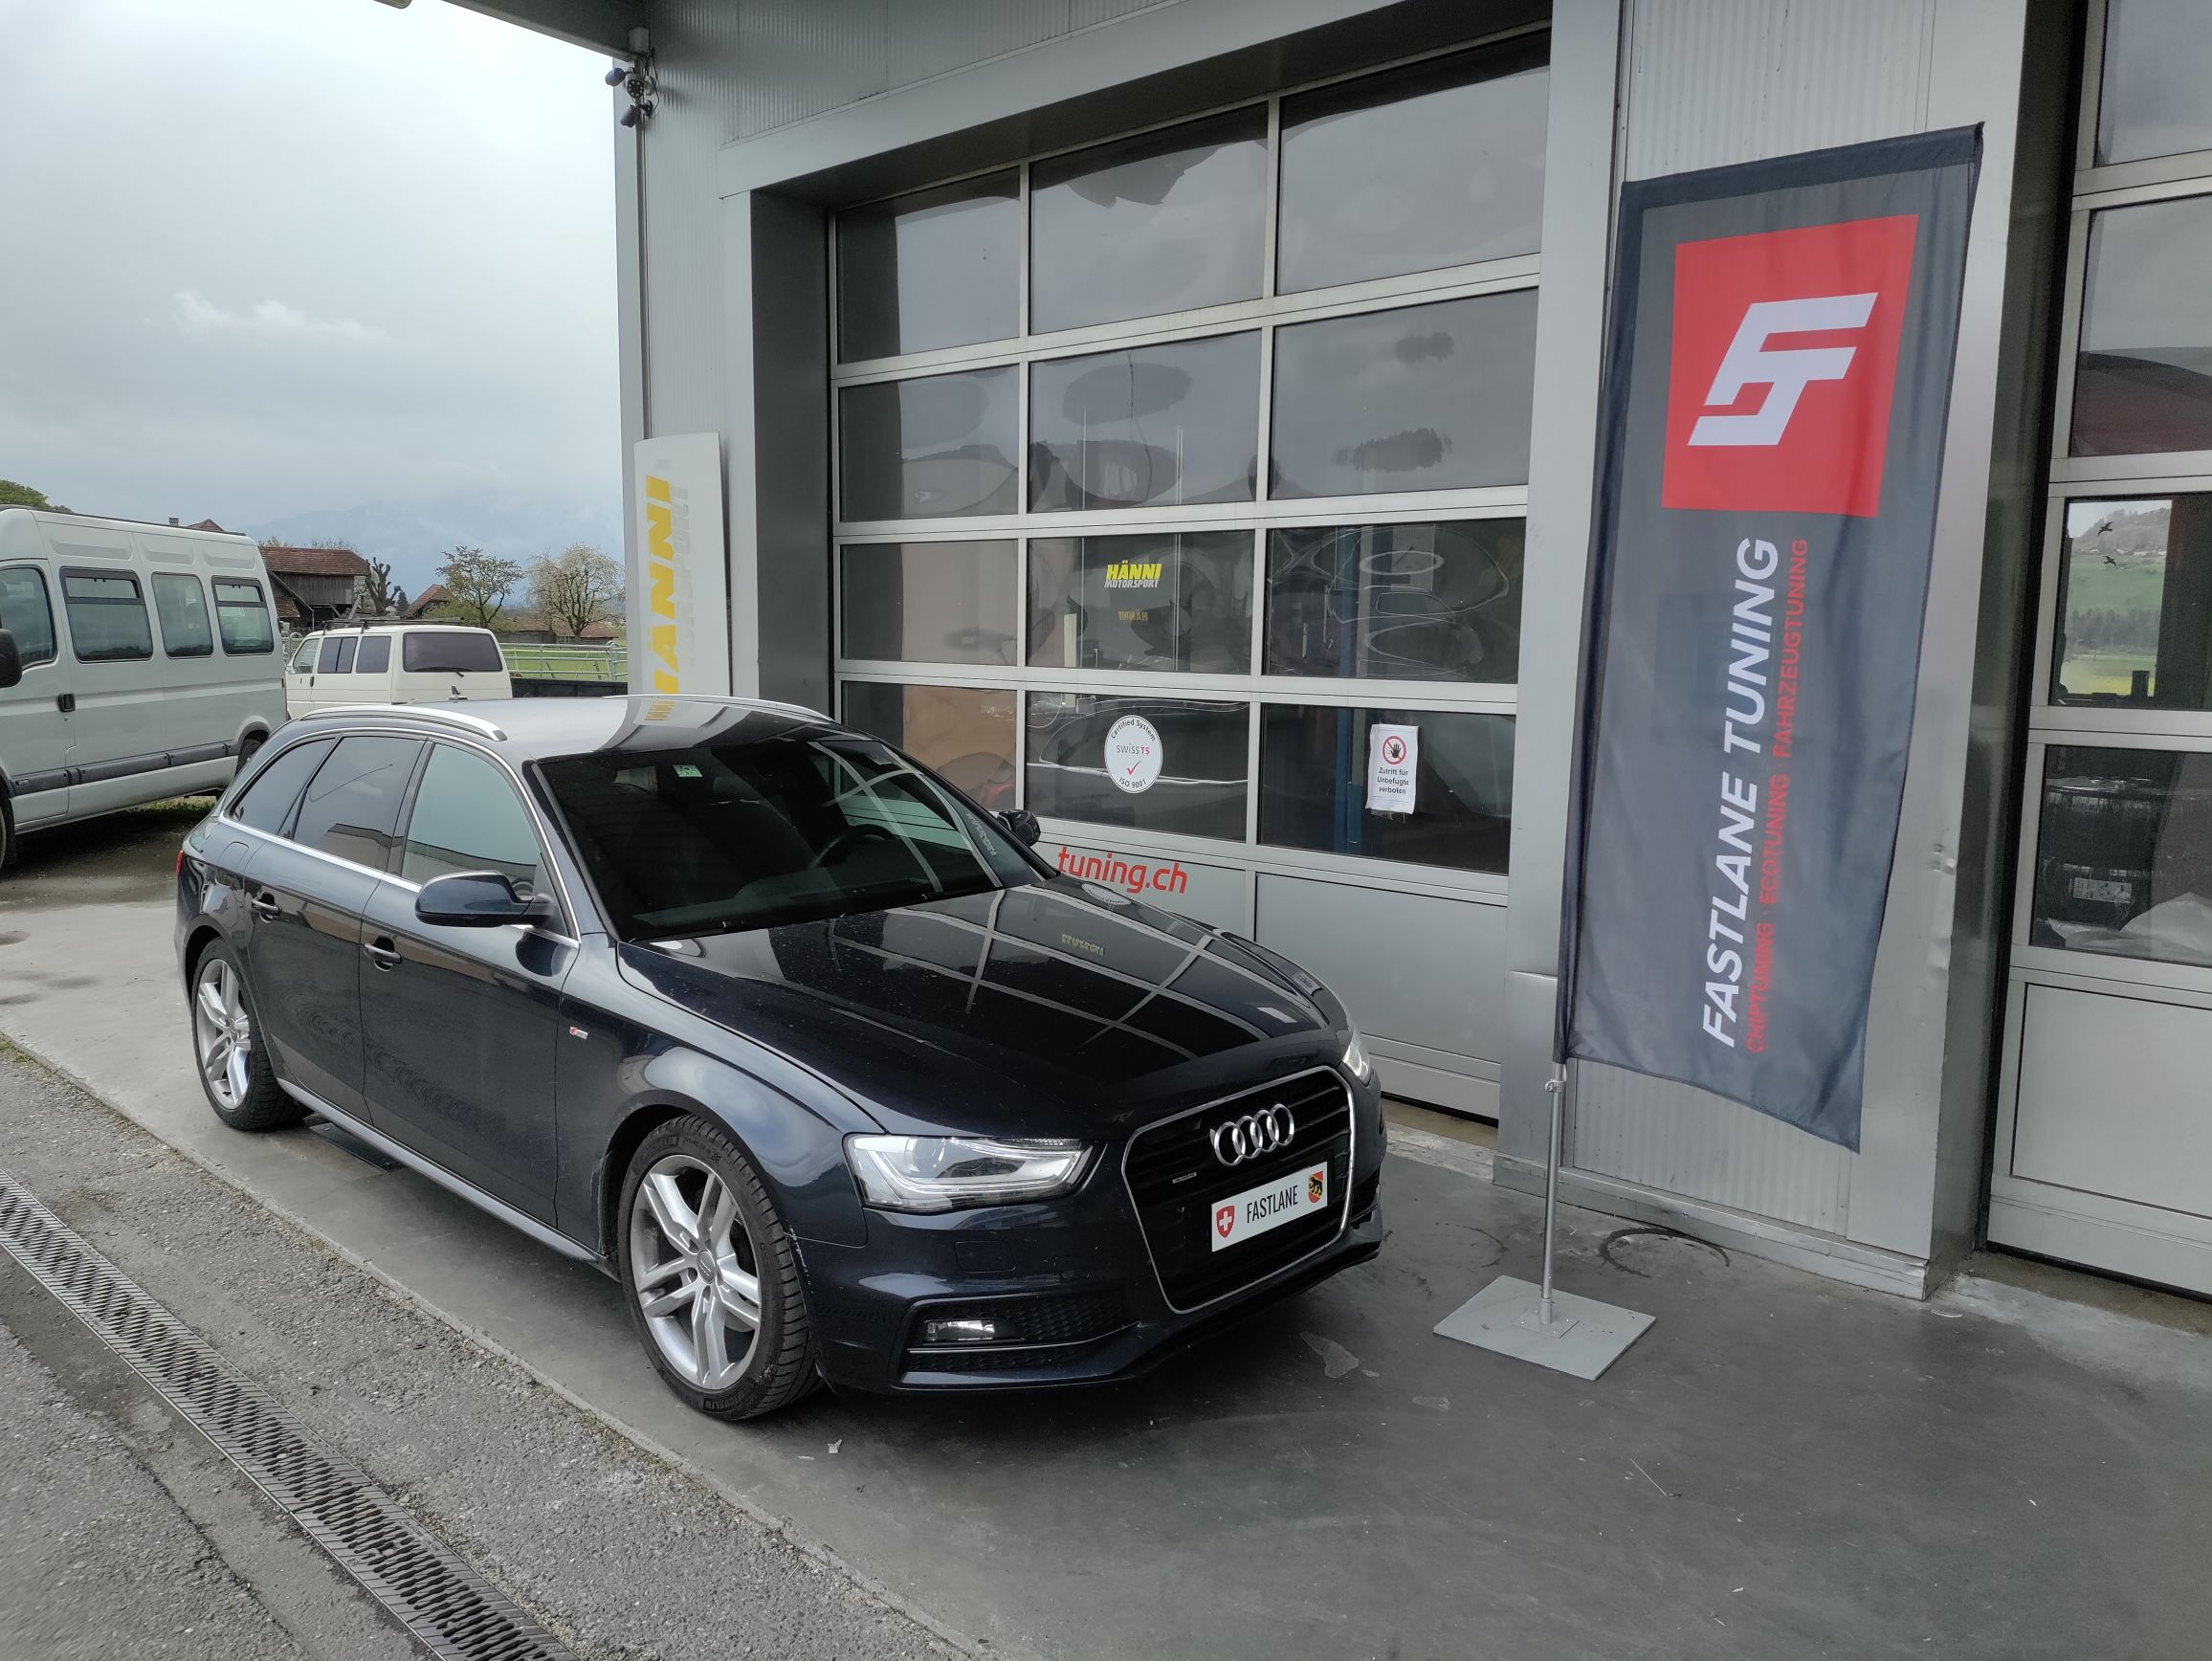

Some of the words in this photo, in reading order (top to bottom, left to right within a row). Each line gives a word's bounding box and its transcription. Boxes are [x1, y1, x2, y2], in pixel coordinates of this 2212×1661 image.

[1103, 579, 1160, 588] MOTORSPORT
[1106, 560, 1162, 580] HÄNNI
[1723, 537, 1779, 754] TUNING
[1772, 538, 1808, 758] FAHRZEUGTUNING
[1111, 719, 1135, 739] Certified
[1136, 720, 1156, 742] System
[1118, 776, 1130, 787] ISO
[1131, 779, 1146, 788] 9001
[1377, 776, 1409, 786] Unbefugte
[1379, 767, 1397, 776] Zutritt
[1378, 786, 1406, 795] verboten
[1759, 773, 1790, 905] ECOTUNING
[1058, 846, 1188, 894] tuning.ch
[1703, 771, 1758, 1049] FASTLANE
[1746, 922, 1775, 1054] CHIPTUNING
[1247, 1185, 1298, 1224] FASTLANE
